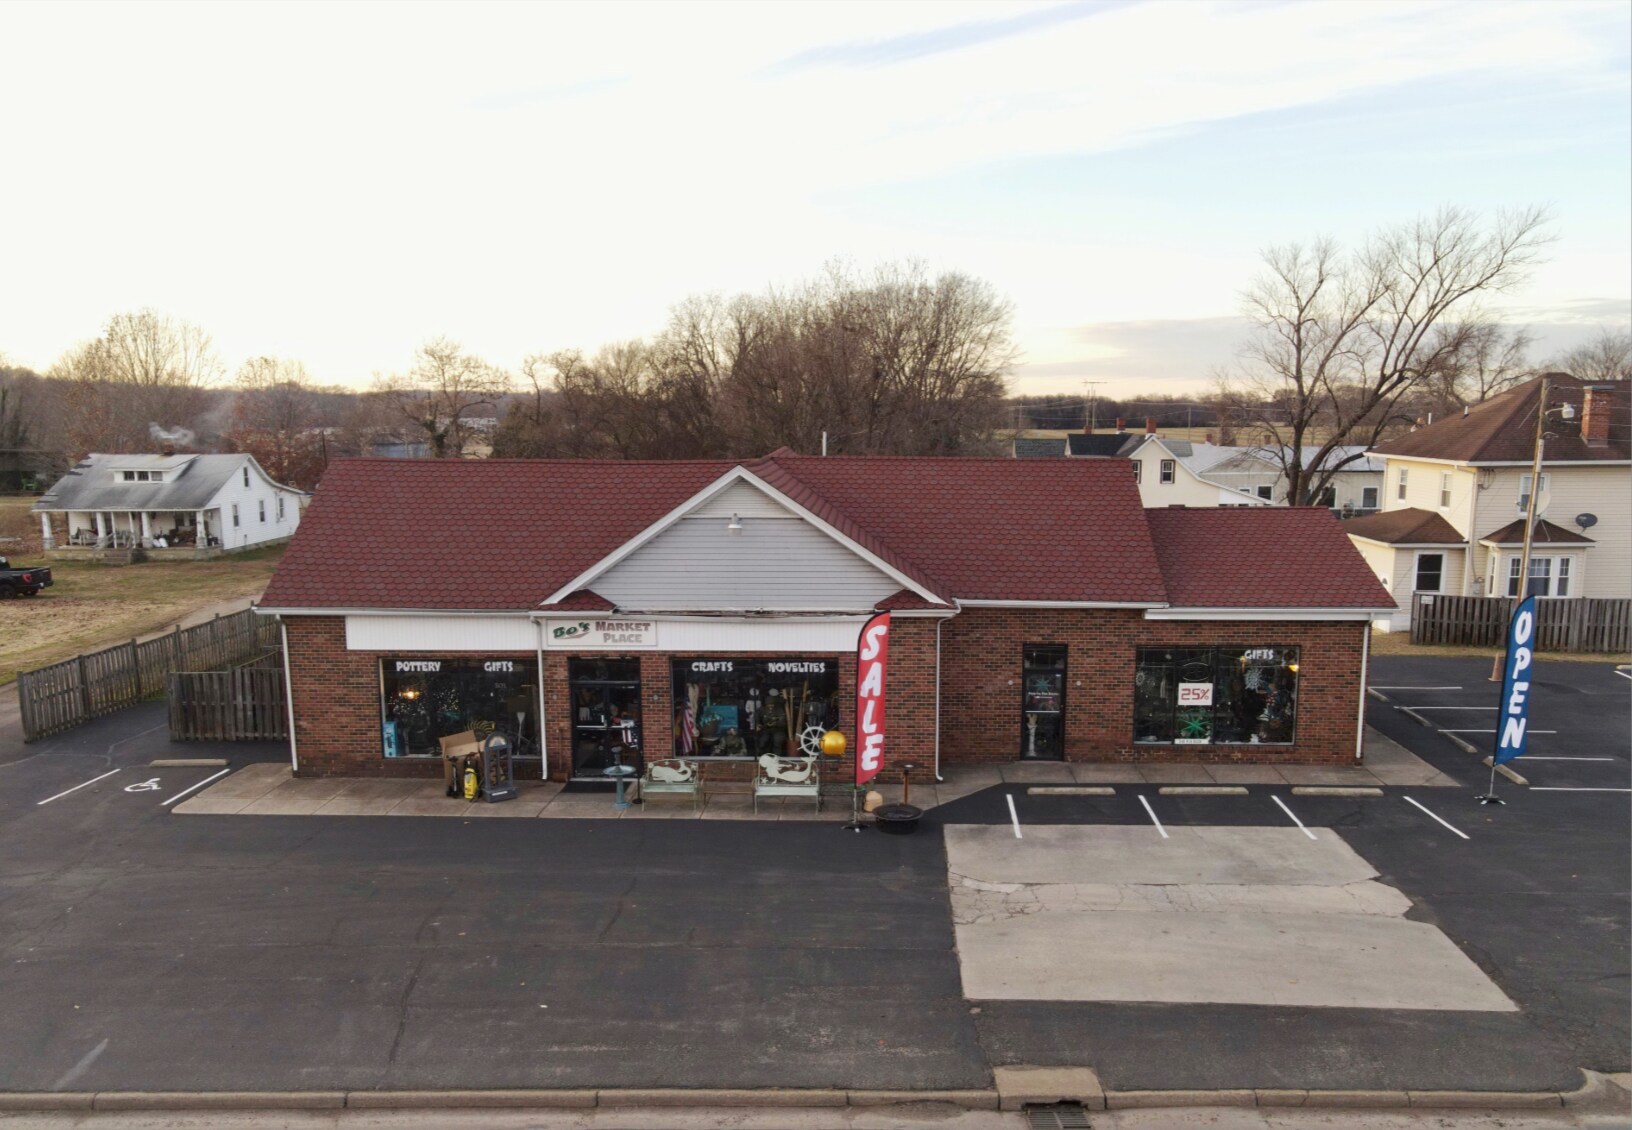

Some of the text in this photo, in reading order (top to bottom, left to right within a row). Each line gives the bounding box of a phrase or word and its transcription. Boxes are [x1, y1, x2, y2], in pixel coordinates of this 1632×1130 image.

[595, 621, 651, 632] MARKET
[603, 633, 643, 643] PLACE
[1244, 650, 1274, 660] GIFTS
[396, 661, 441, 673] POTTERY
[484, 661, 513, 672] GIFTS
[691, 662, 733, 672] CRAFTS
[768, 662, 825, 673] NOVELTIES
[1500, 611, 1532, 748] OPEN
[860, 625, 887, 771] SALE
[1181, 688, 1210, 700] 25%
